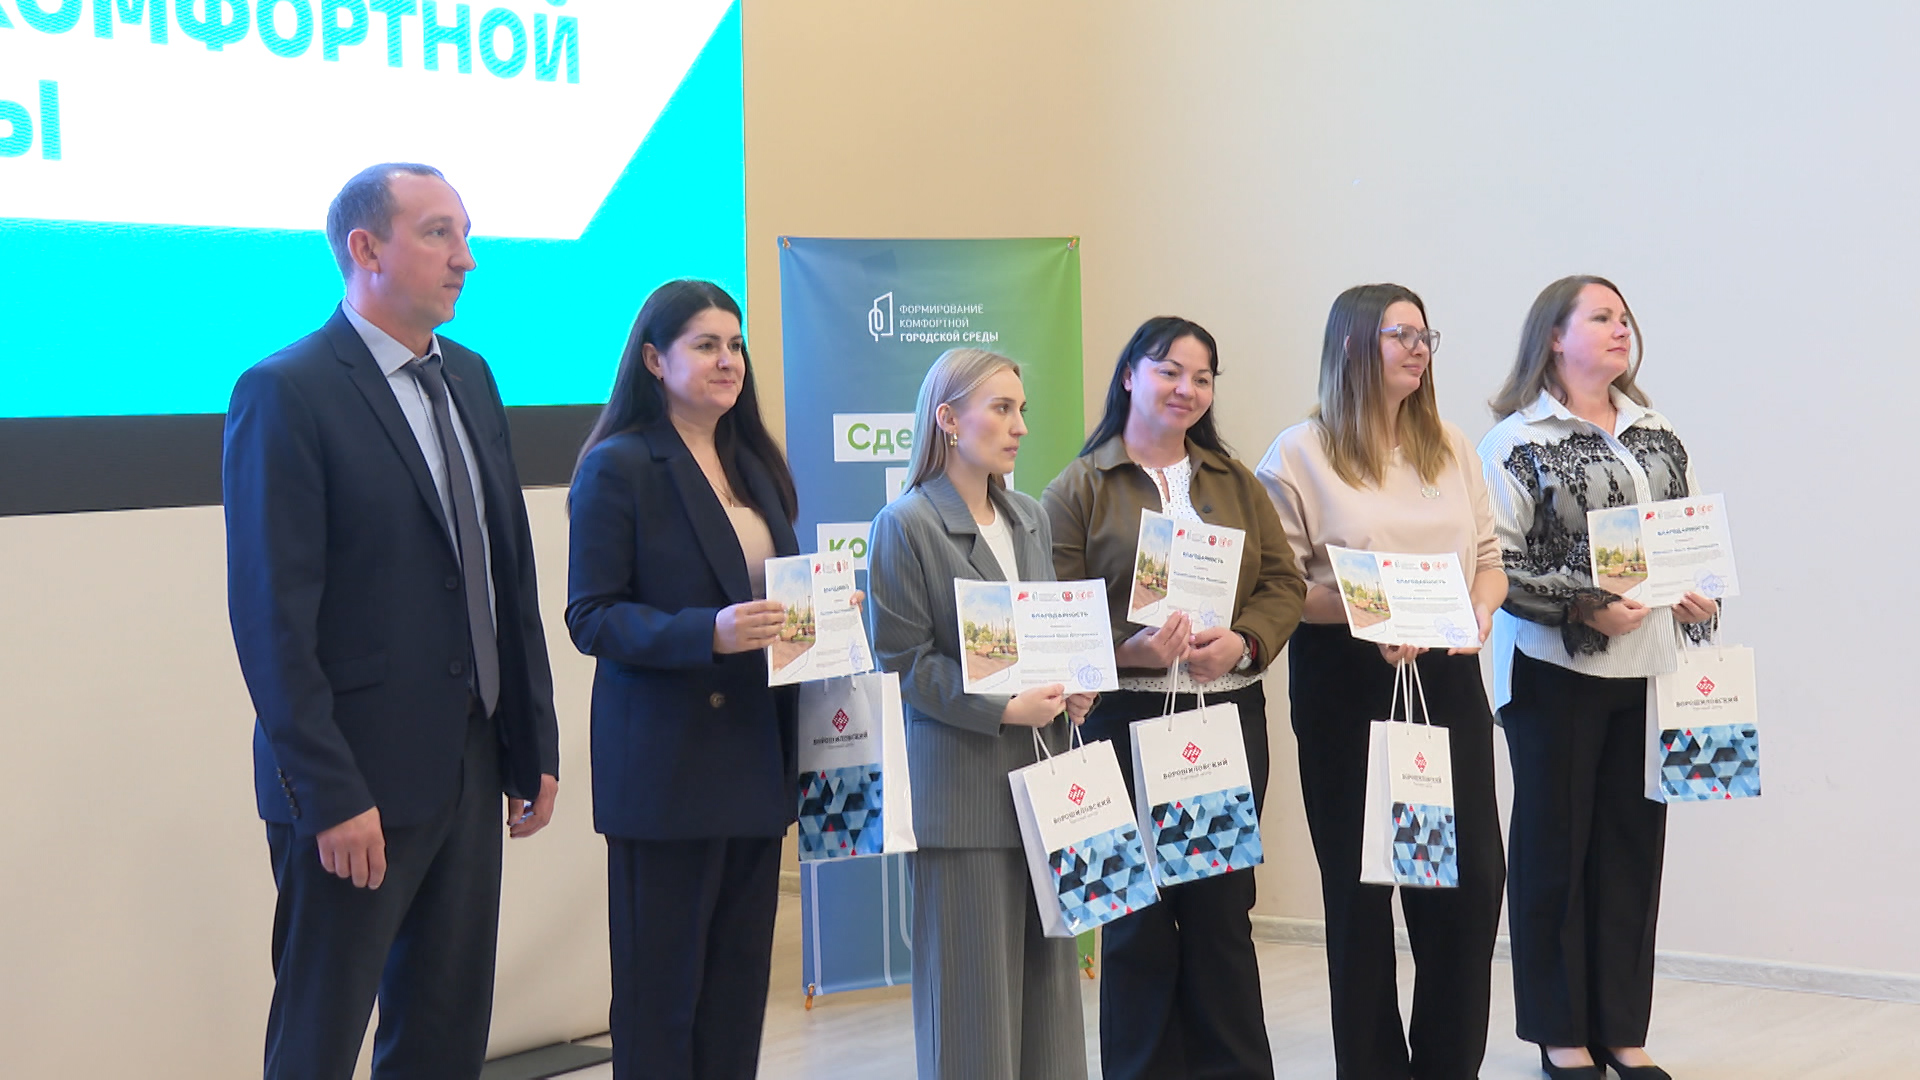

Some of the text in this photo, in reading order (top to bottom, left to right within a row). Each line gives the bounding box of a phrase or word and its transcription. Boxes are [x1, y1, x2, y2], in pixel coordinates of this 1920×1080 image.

[0, 0, 581, 84] МФОРТНОЙ
[899, 303, 984, 315] ФОРМИРОВАНИЕ
[899, 316, 969, 328] КОМФОРТНОЙ
[900, 330, 999, 343] ГОРОДСКОЙ СРЕДЫ
